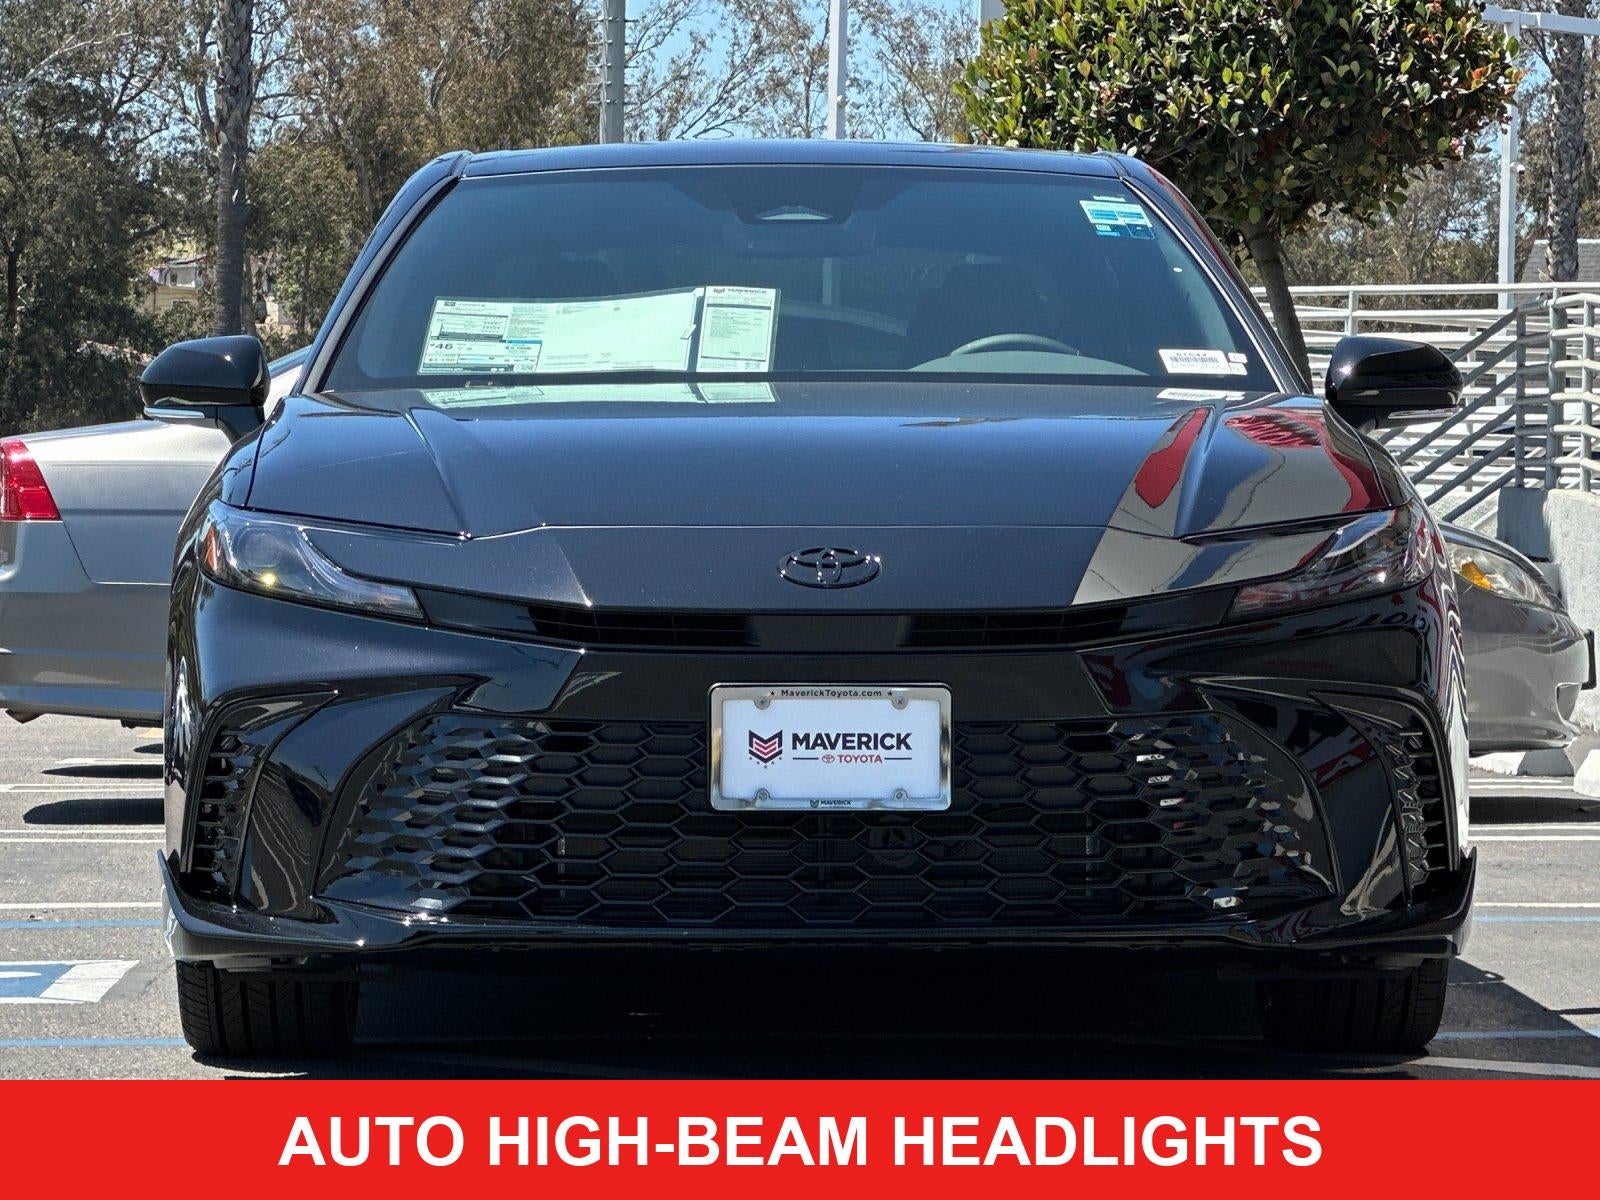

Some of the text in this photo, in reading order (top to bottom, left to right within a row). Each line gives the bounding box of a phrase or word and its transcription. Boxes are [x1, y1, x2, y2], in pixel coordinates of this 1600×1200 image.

[781, 689, 882, 698] MaverickToyota.com
[791, 732, 913, 751] MAVERICK
[837, 754, 883, 764] TOYOTA
